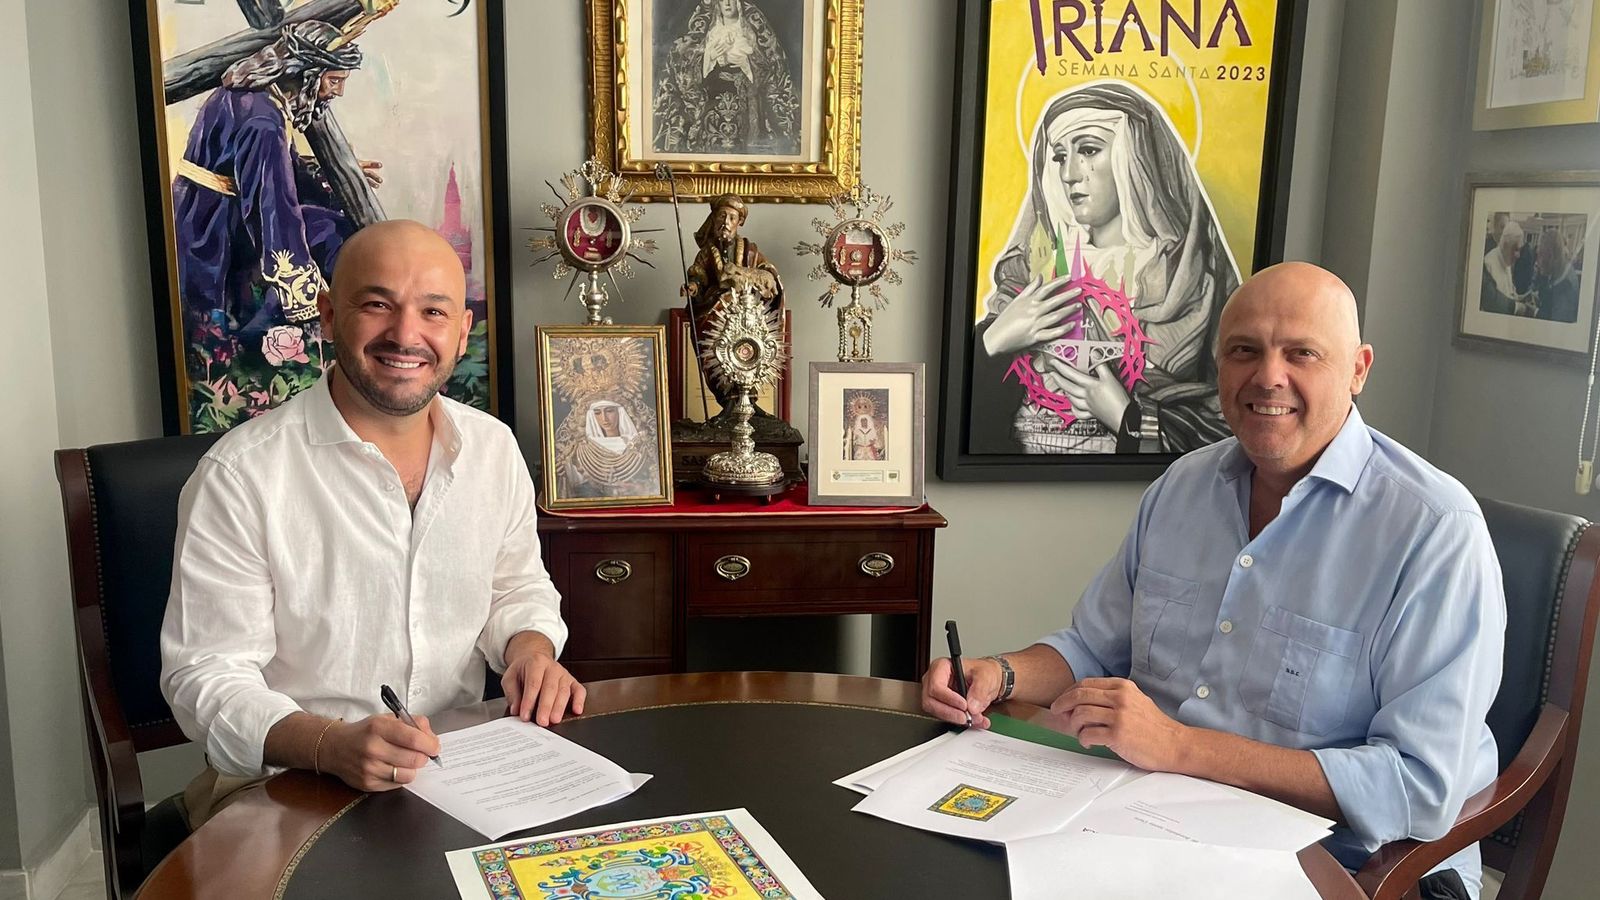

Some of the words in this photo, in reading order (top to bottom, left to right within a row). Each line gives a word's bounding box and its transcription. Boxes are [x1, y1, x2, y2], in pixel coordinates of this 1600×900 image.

[1029, 0, 1252, 76] TRIANA
[1057, 59, 1139, 77] SEMANA
[1148, 61, 1210, 80] SANTA
[1216, 65, 1265, 81] 2023
